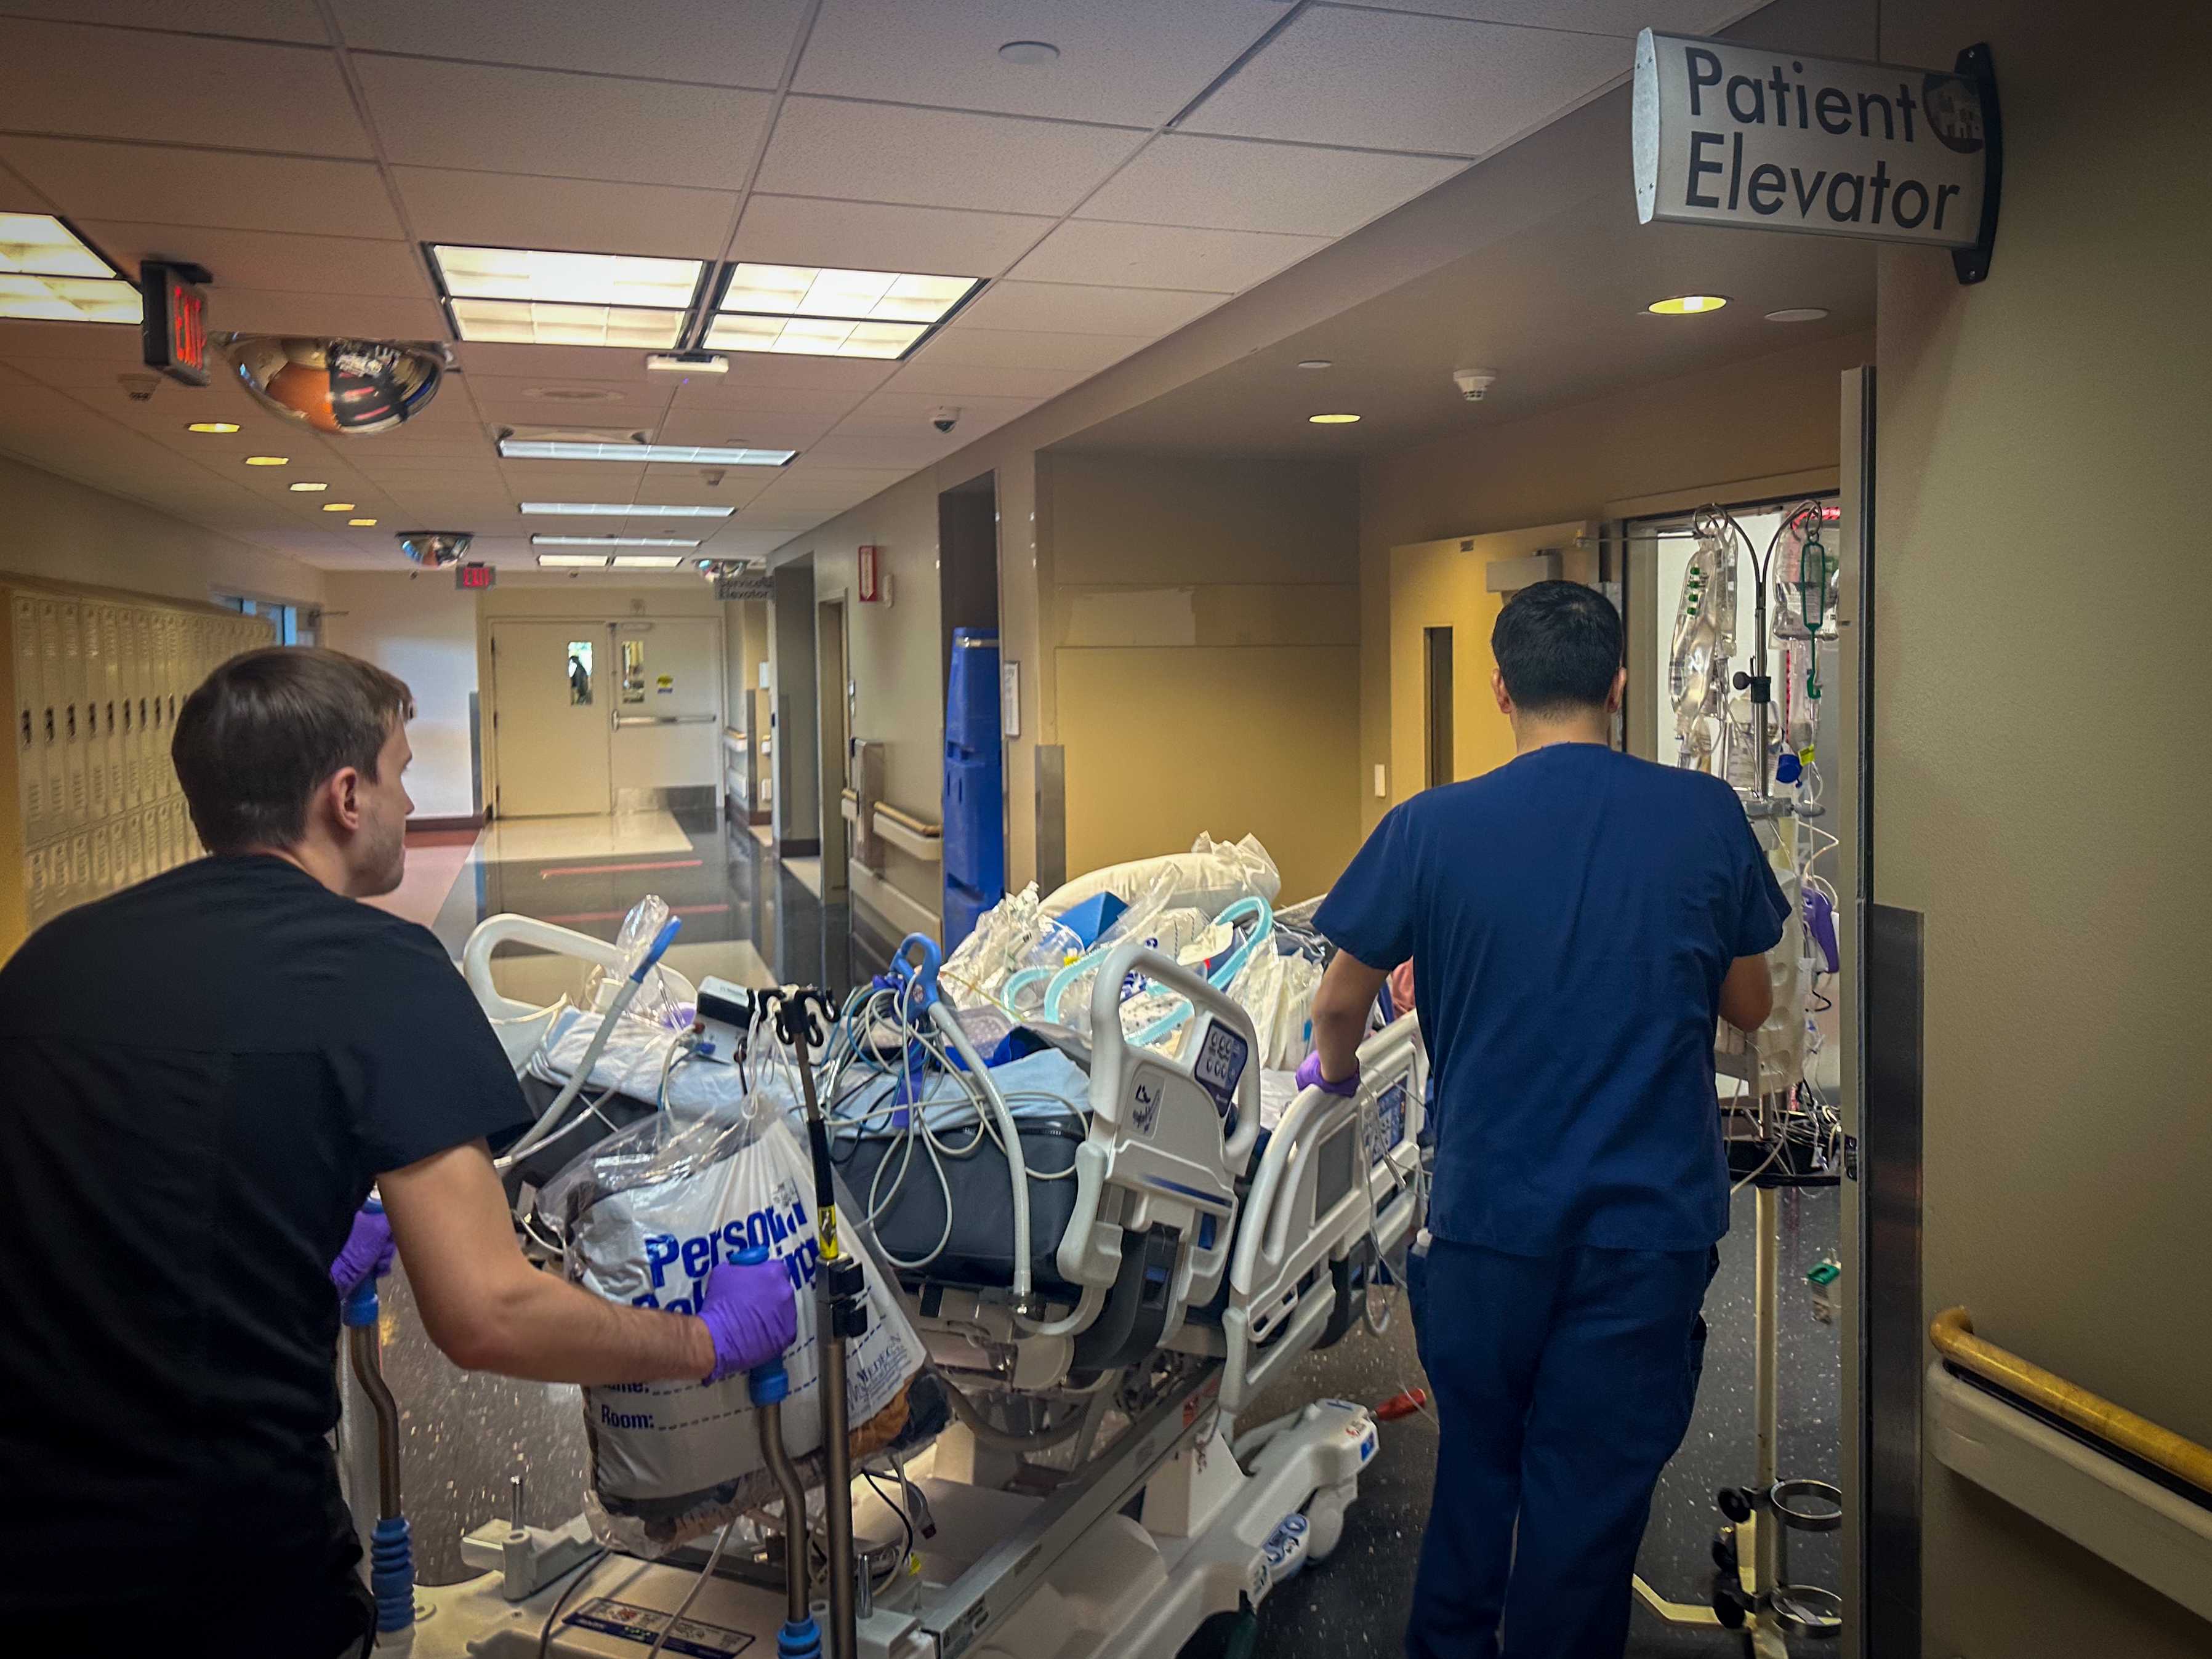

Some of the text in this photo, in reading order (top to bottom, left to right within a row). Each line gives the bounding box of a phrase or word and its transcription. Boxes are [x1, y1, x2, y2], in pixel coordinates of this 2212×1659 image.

[1684, 46, 1916, 142] Patient
[1686, 131, 1960, 230] Elevator
[644, 1202, 808, 1288] Person
[601, 1404, 654, 1428] Room:
